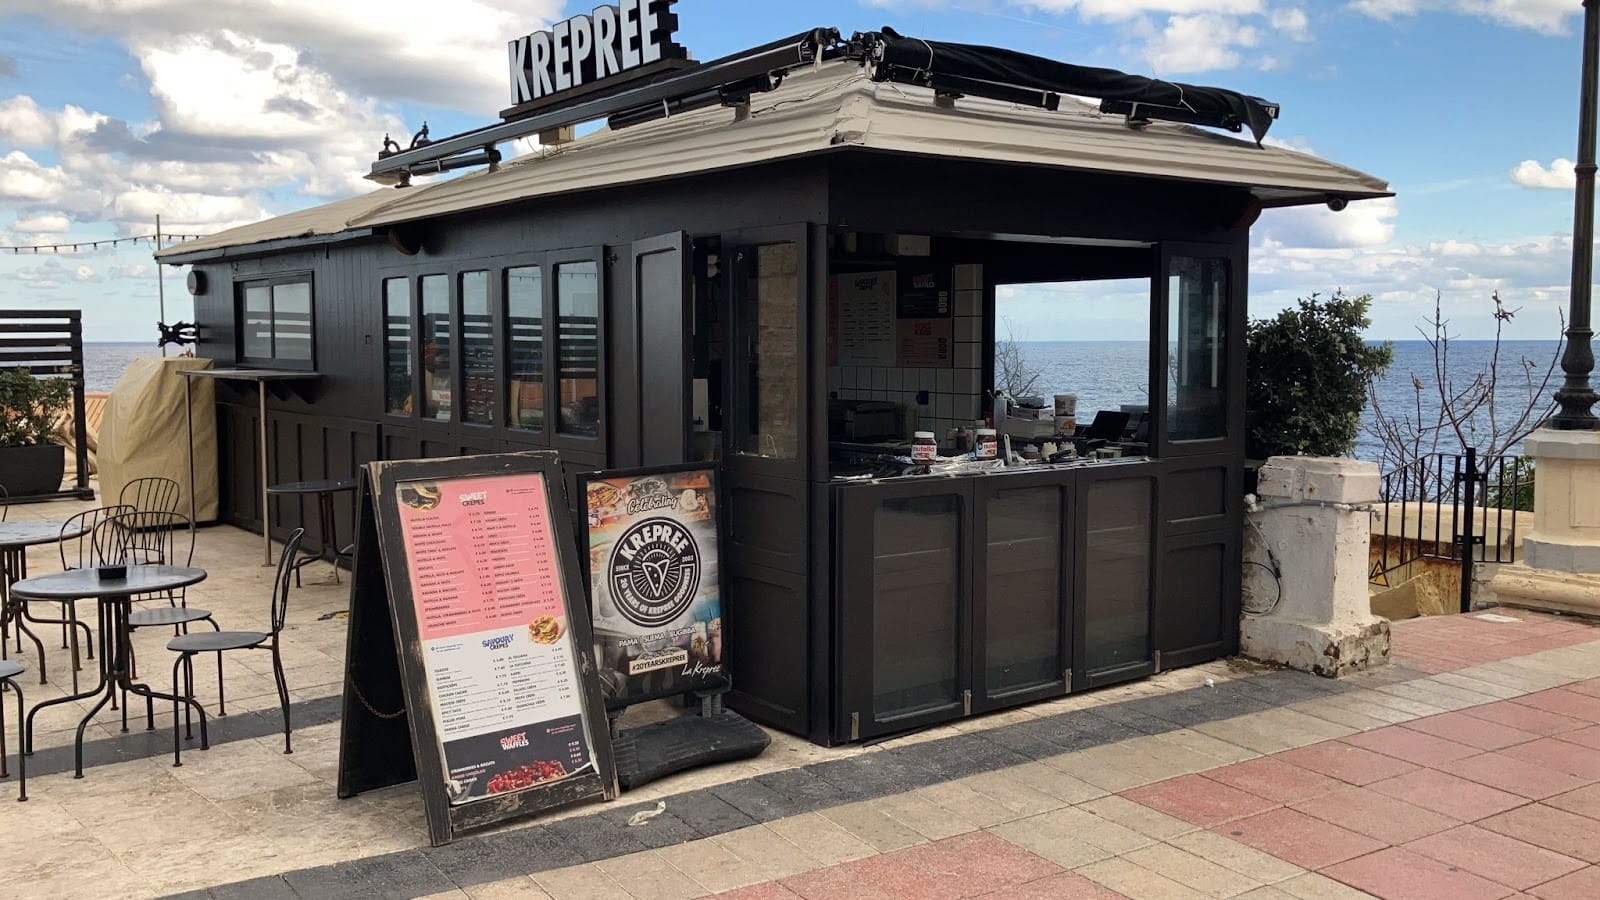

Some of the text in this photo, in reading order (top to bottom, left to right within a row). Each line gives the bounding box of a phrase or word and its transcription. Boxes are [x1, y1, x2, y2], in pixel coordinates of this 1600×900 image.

[508, 0, 662, 105] KREPREE
[459, 490, 487, 502] SWEET
[627, 494, 678, 515] Celebrating
[620, 524, 689, 561] KREPREE
[620, 578, 628, 588] 20
[624, 588, 640, 608] YEARS
[640, 604, 648, 613] OF
[648, 601, 675, 614] KREPREE
[482, 634, 514, 648] SAVOURY
[619, 638, 639, 648] PAMA
[631, 654, 686, 670] #20YEARSKREPREE
[681, 664, 691, 676] La
[500, 732, 526, 745] SWEET
[501, 739, 529, 750] WAFFLES
